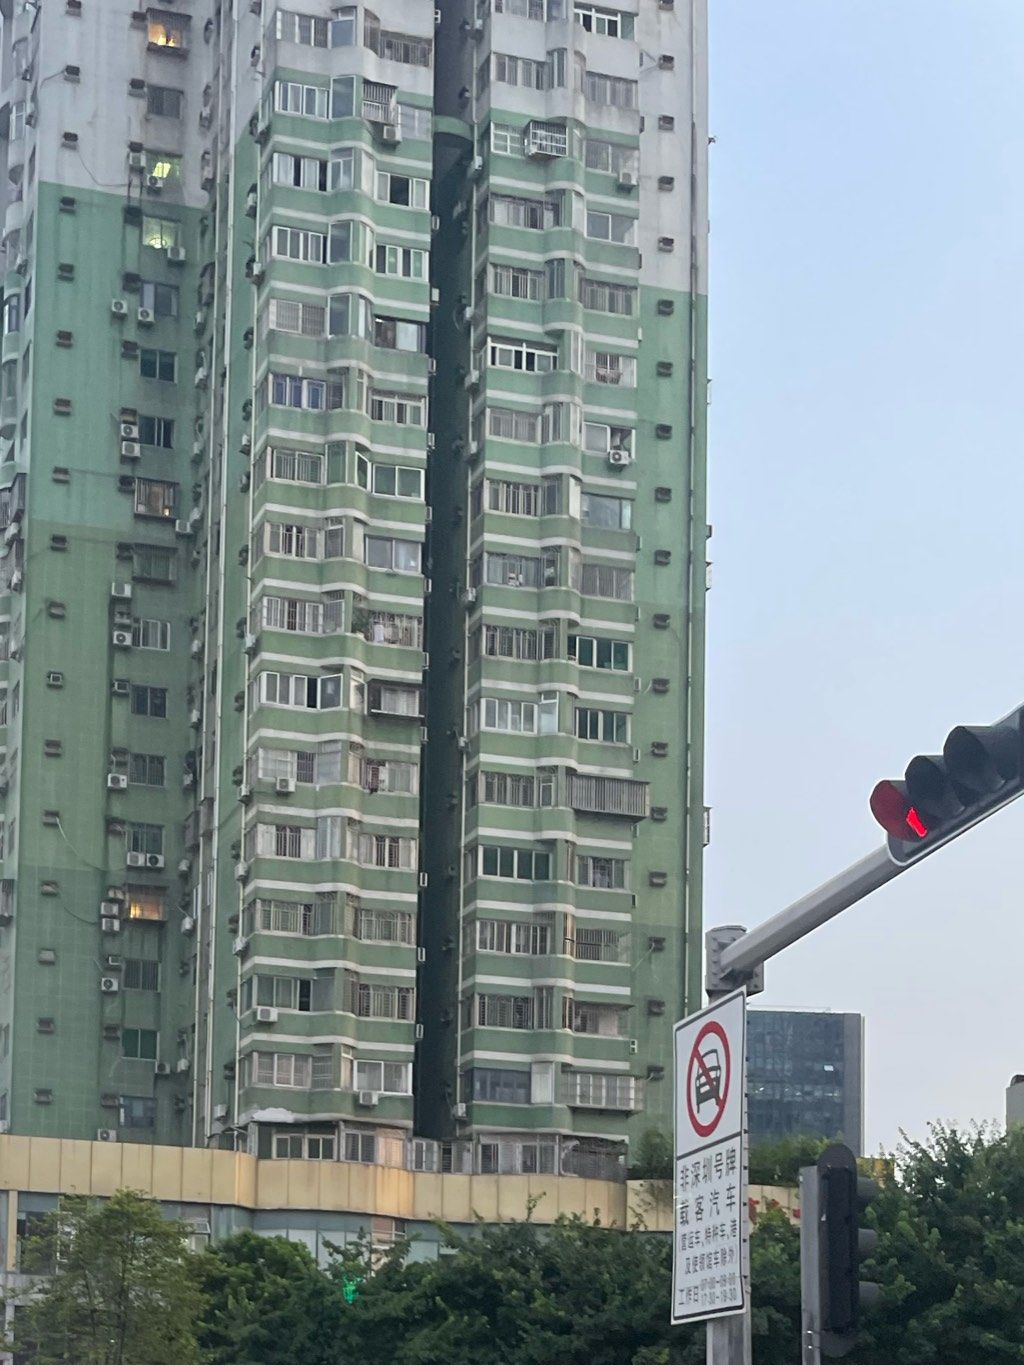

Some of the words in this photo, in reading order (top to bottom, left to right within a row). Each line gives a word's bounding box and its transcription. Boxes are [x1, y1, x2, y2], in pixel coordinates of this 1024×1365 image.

[680, 1147, 736, 1191] 非深圳号牌
[680, 1183, 736, 1226] 载客汽车
